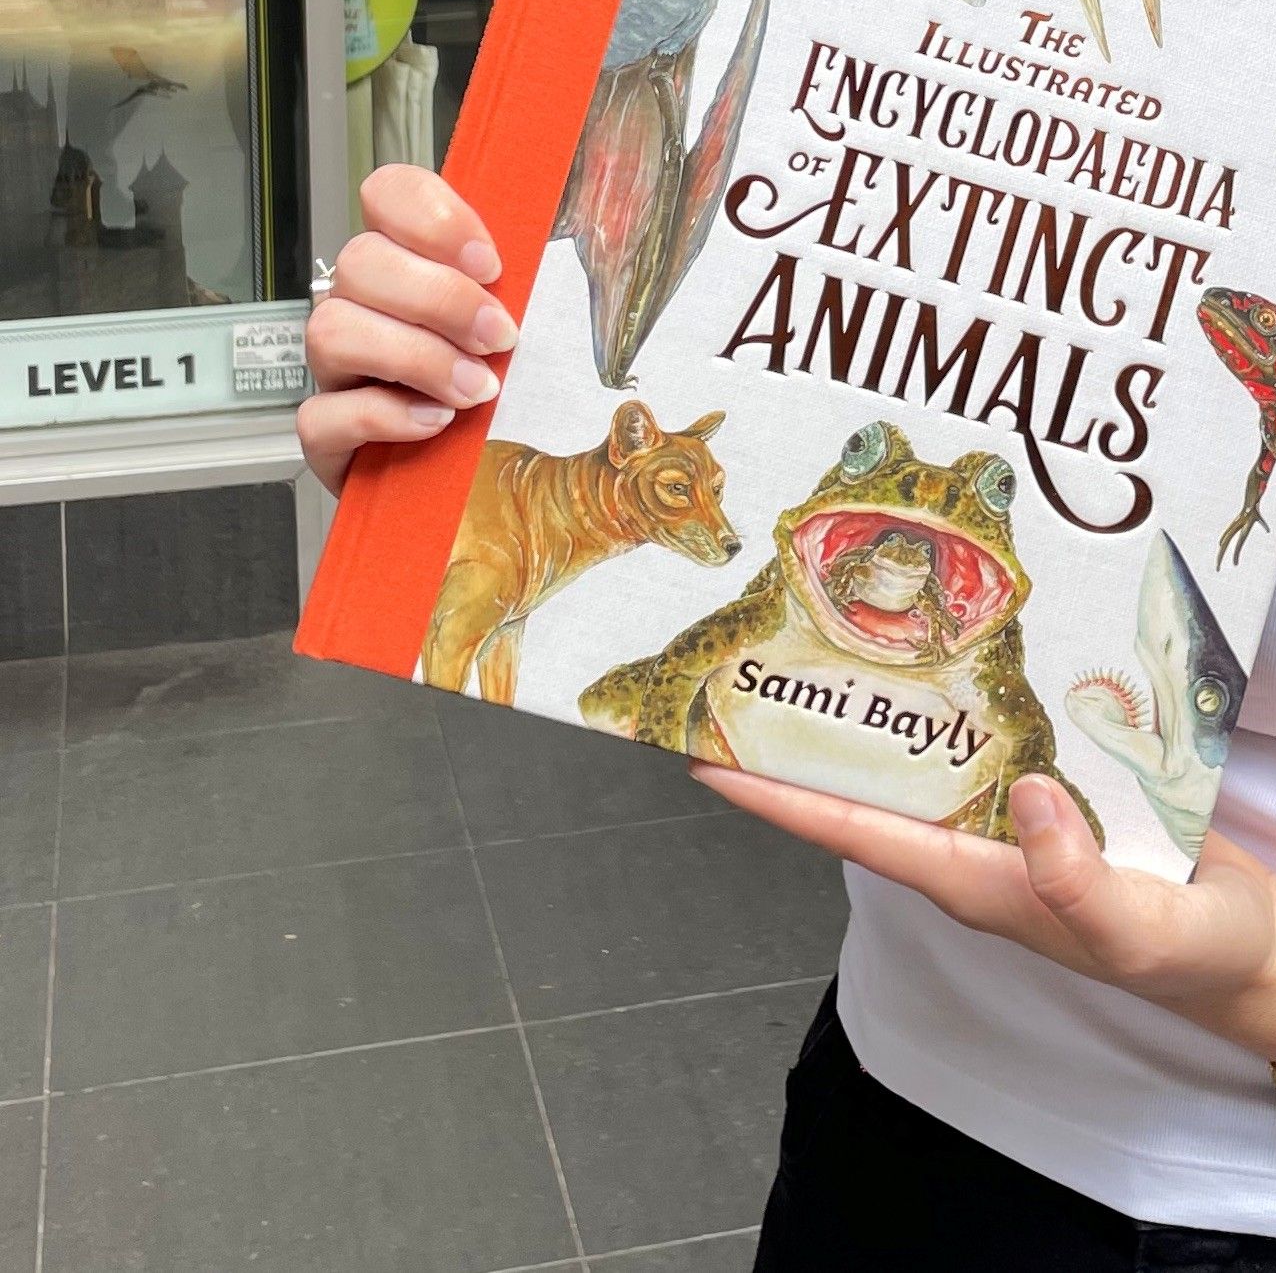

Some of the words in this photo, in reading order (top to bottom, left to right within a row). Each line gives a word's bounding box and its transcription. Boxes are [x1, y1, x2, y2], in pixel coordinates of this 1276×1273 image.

[790, 39, 1240, 232] ENCYCLOPAEDIA
[724, 144, 1214, 347] EXTINCT
[27, 354, 165, 399] LEVEL
[177, 353, 197, 386] 1
[714, 250, 1166, 535] ANIMALS
[732, 659, 856, 720] Sami
[860, 693, 995, 768] Bayly
